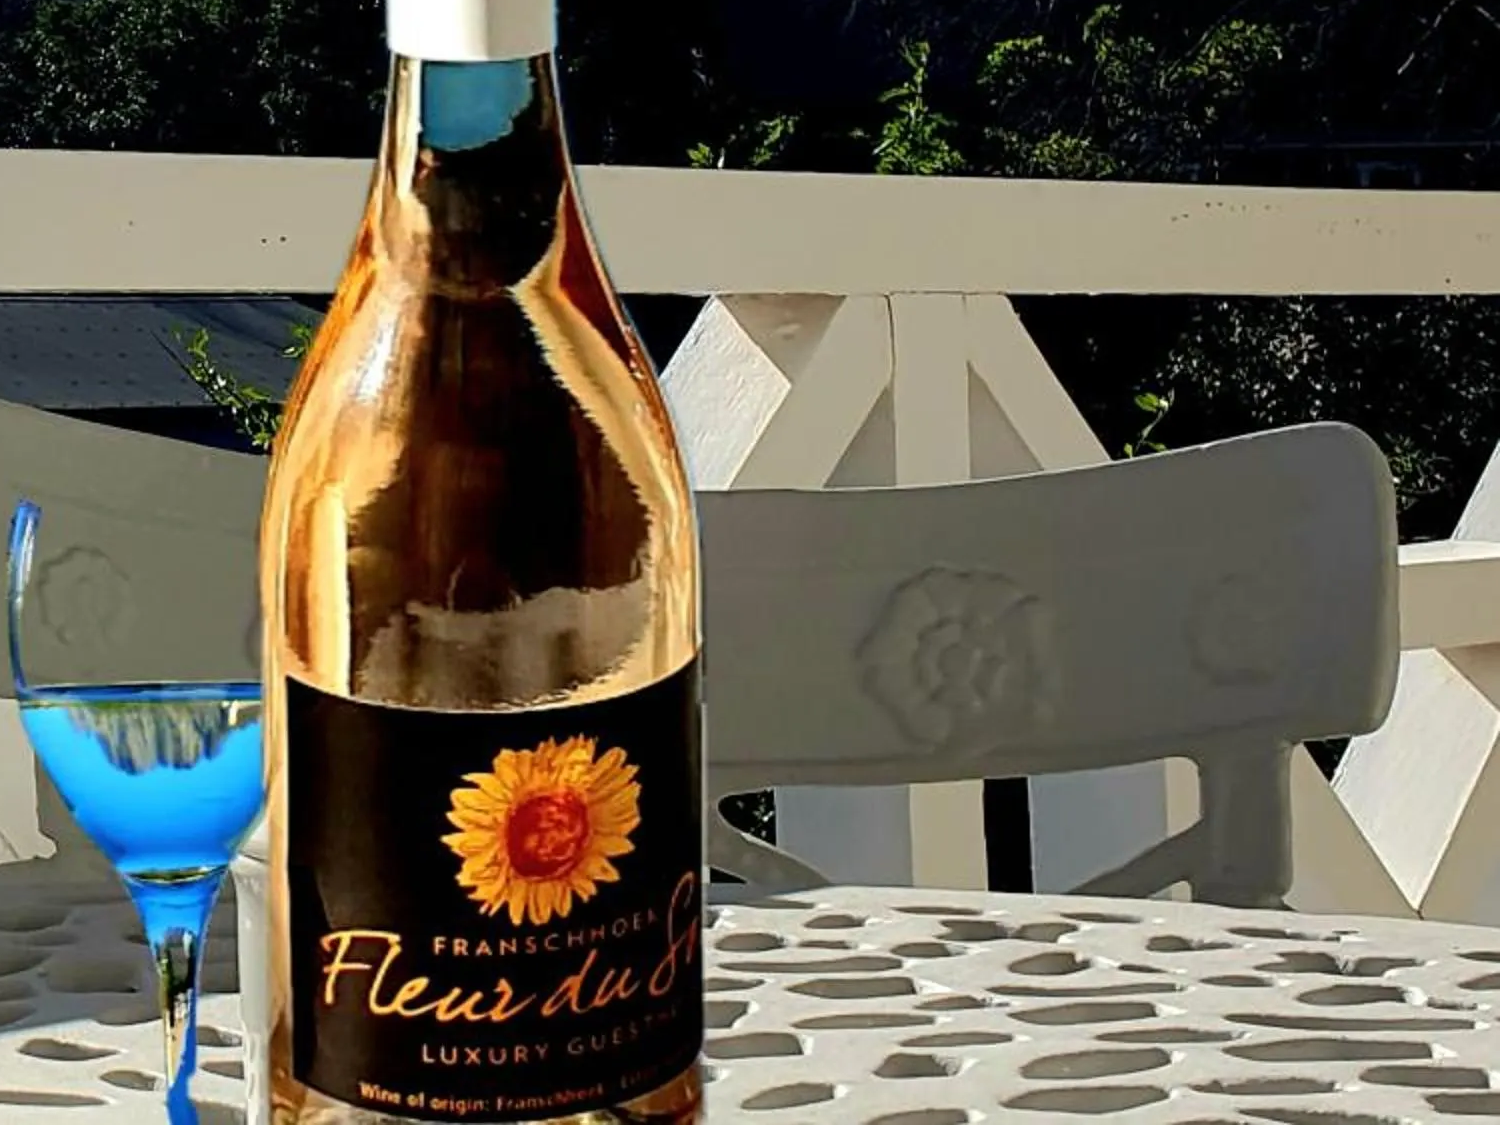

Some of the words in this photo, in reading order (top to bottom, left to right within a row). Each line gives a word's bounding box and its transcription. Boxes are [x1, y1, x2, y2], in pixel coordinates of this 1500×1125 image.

[319, 929, 538, 1022] Fleur
[540, 948, 641, 1017] du
[421, 1042, 550, 1066] LUXURY
[357, 1080, 402, 1105] Wine
